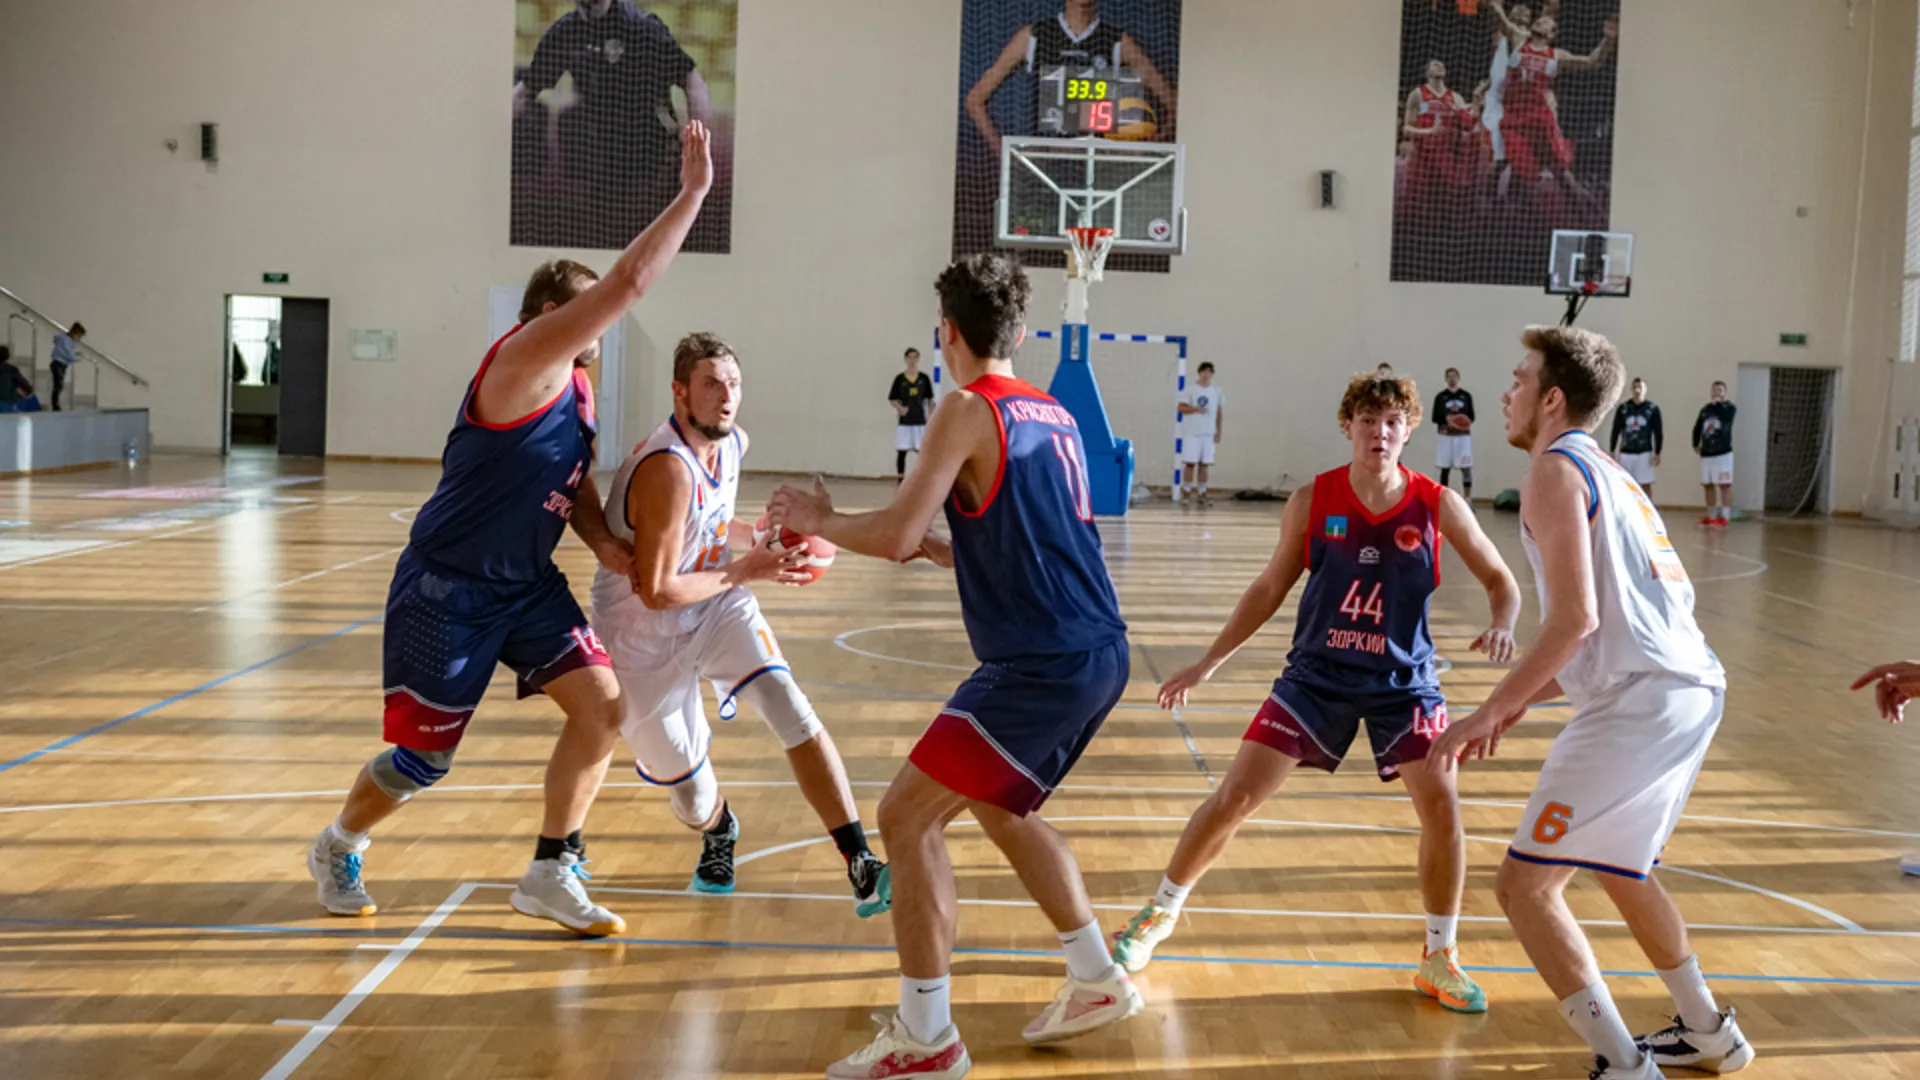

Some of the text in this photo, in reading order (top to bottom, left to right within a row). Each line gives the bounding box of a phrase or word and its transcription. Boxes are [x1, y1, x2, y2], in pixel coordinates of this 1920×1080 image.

[1067, 79, 1107, 99] 33.9
[1089, 101, 1113, 131] 15
[1050, 431, 1093, 522] 11
[1339, 579, 1384, 625] 44
[1533, 802, 1574, 844] 6
